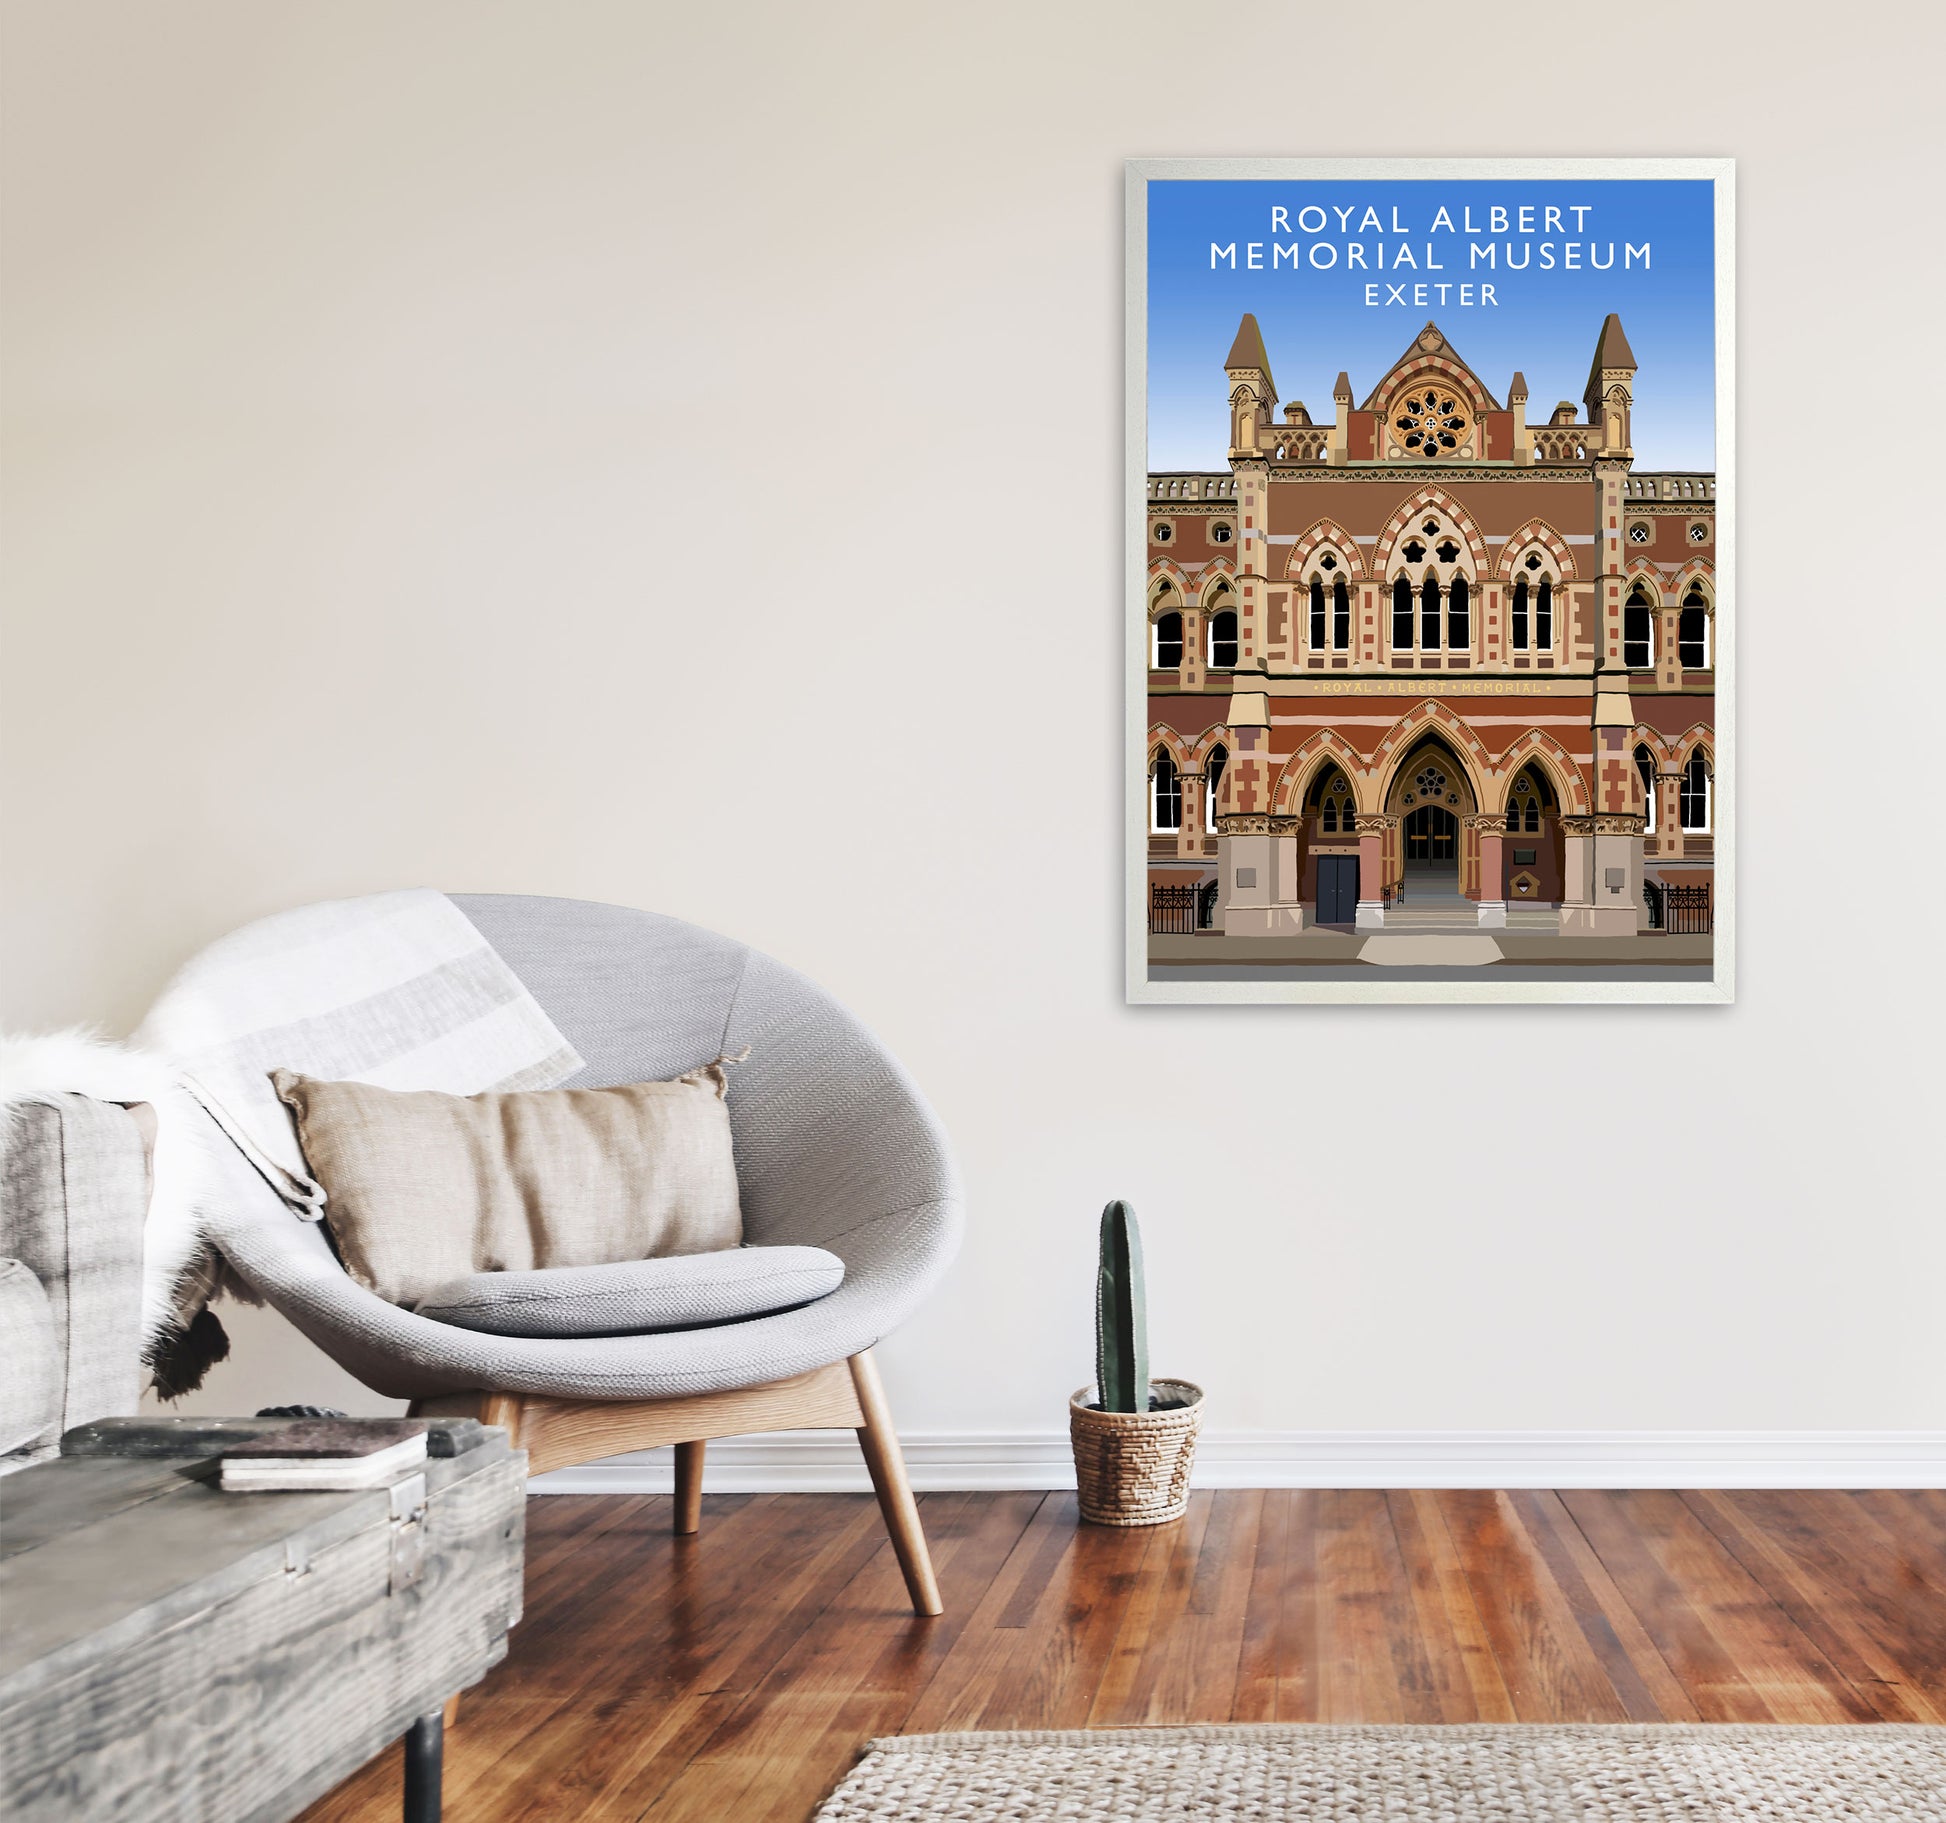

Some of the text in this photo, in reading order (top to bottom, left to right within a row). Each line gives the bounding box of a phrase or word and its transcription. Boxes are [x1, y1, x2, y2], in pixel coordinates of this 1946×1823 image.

[1271, 205, 1592, 233] ROYAL ALBERT
[1210, 242, 1652, 270] MEMORIAL MUSEUM
[1364, 283, 1499, 306] EXETER
[1322, 682, 1541, 693] ROYAL ALBERT MEMORIAL
